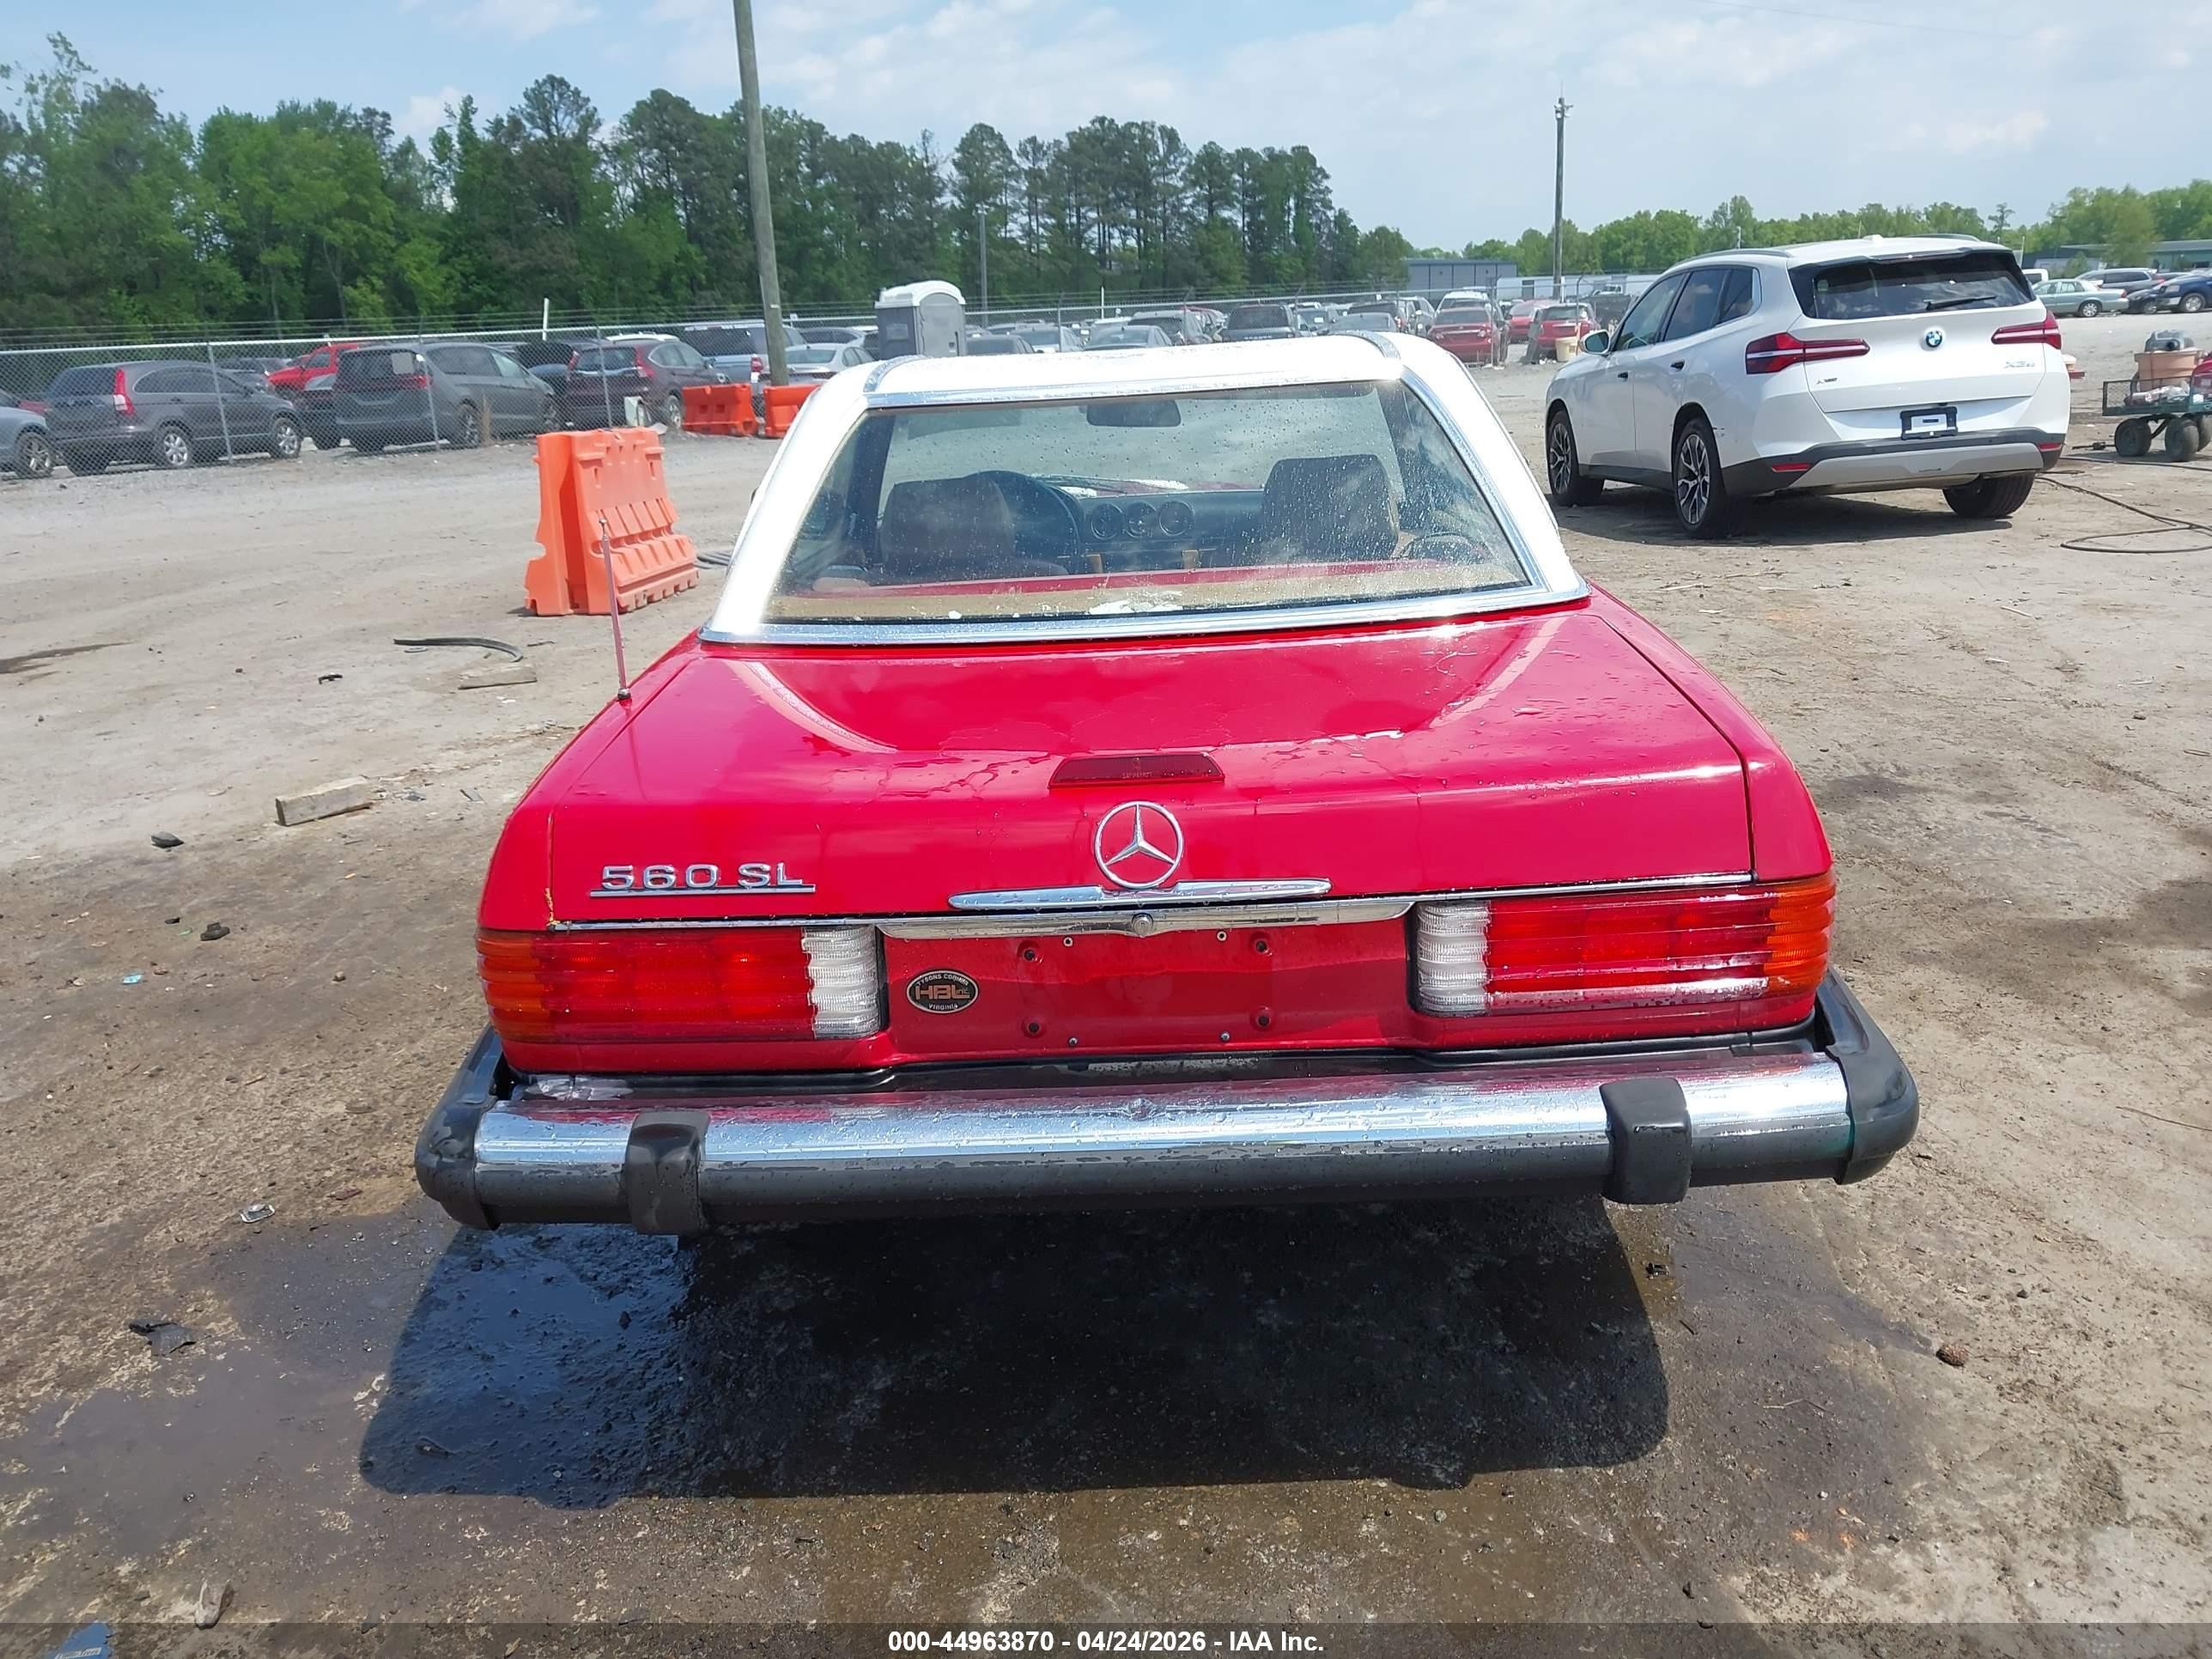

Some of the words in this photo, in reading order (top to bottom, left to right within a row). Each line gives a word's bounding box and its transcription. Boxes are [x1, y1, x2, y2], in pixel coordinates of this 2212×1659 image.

[602, 864, 719, 890] 560
[738, 862, 804, 888] SL
[915, 974, 942, 986] TYSONS
